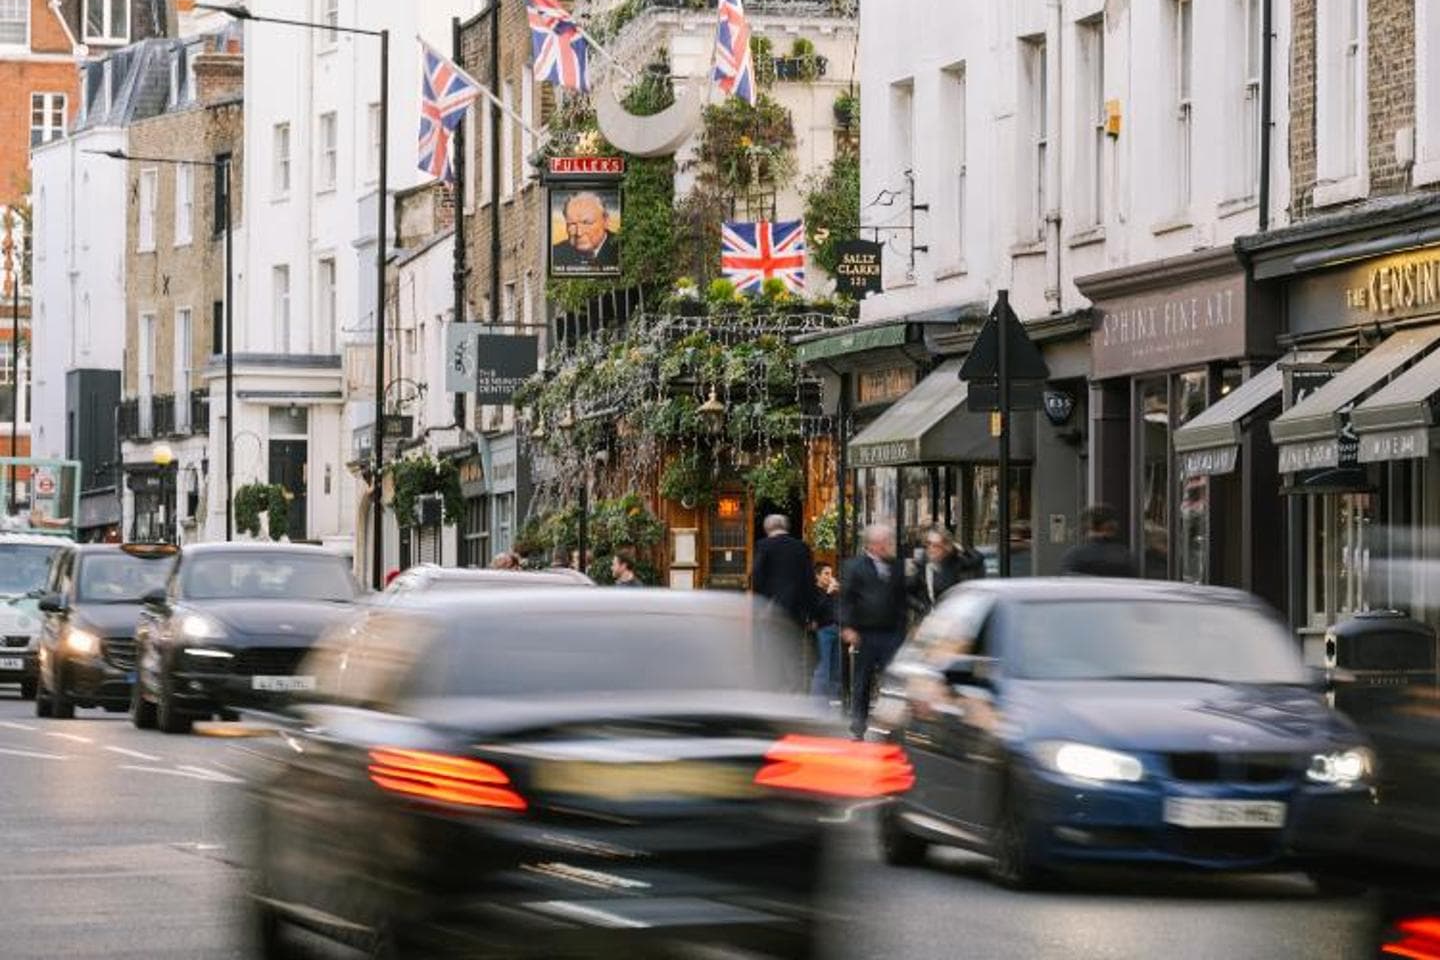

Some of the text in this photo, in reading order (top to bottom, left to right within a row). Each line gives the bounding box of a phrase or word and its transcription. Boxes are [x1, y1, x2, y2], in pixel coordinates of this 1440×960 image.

[843, 253, 876, 264] SALLY
[1347, 289, 1366, 308] THE
[1164, 298, 1198, 336] FINE
[1205, 290, 1233, 327] ART
